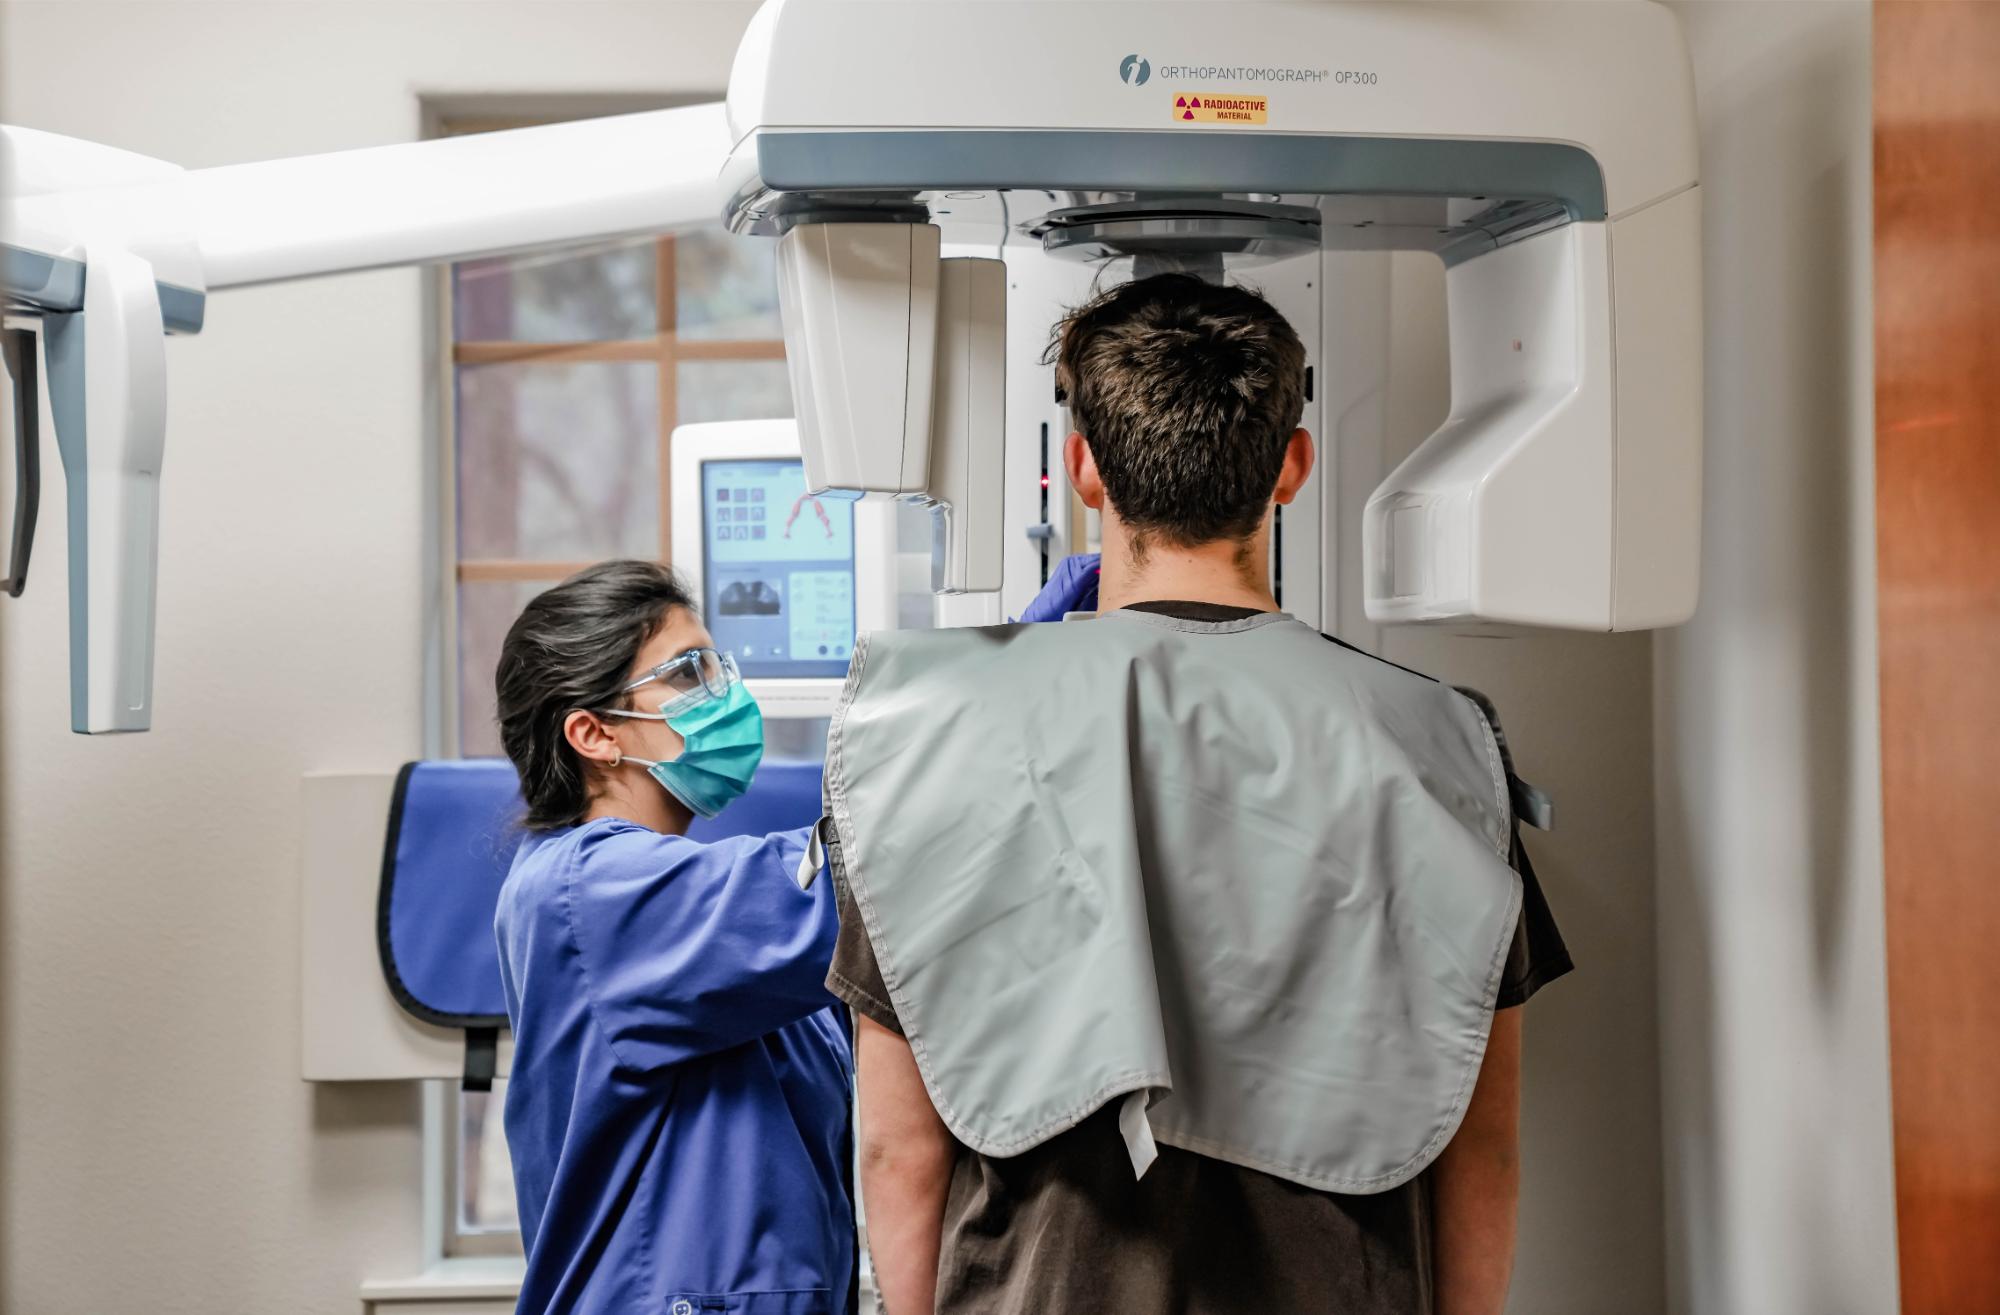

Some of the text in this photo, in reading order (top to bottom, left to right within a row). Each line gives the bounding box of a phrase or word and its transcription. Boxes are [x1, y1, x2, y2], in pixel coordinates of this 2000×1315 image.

[1335, 71, 1378, 85] OP300
[1203, 99, 1266, 111] RADIOACTIVE
[1216, 111, 1252, 121] MATERIAL
